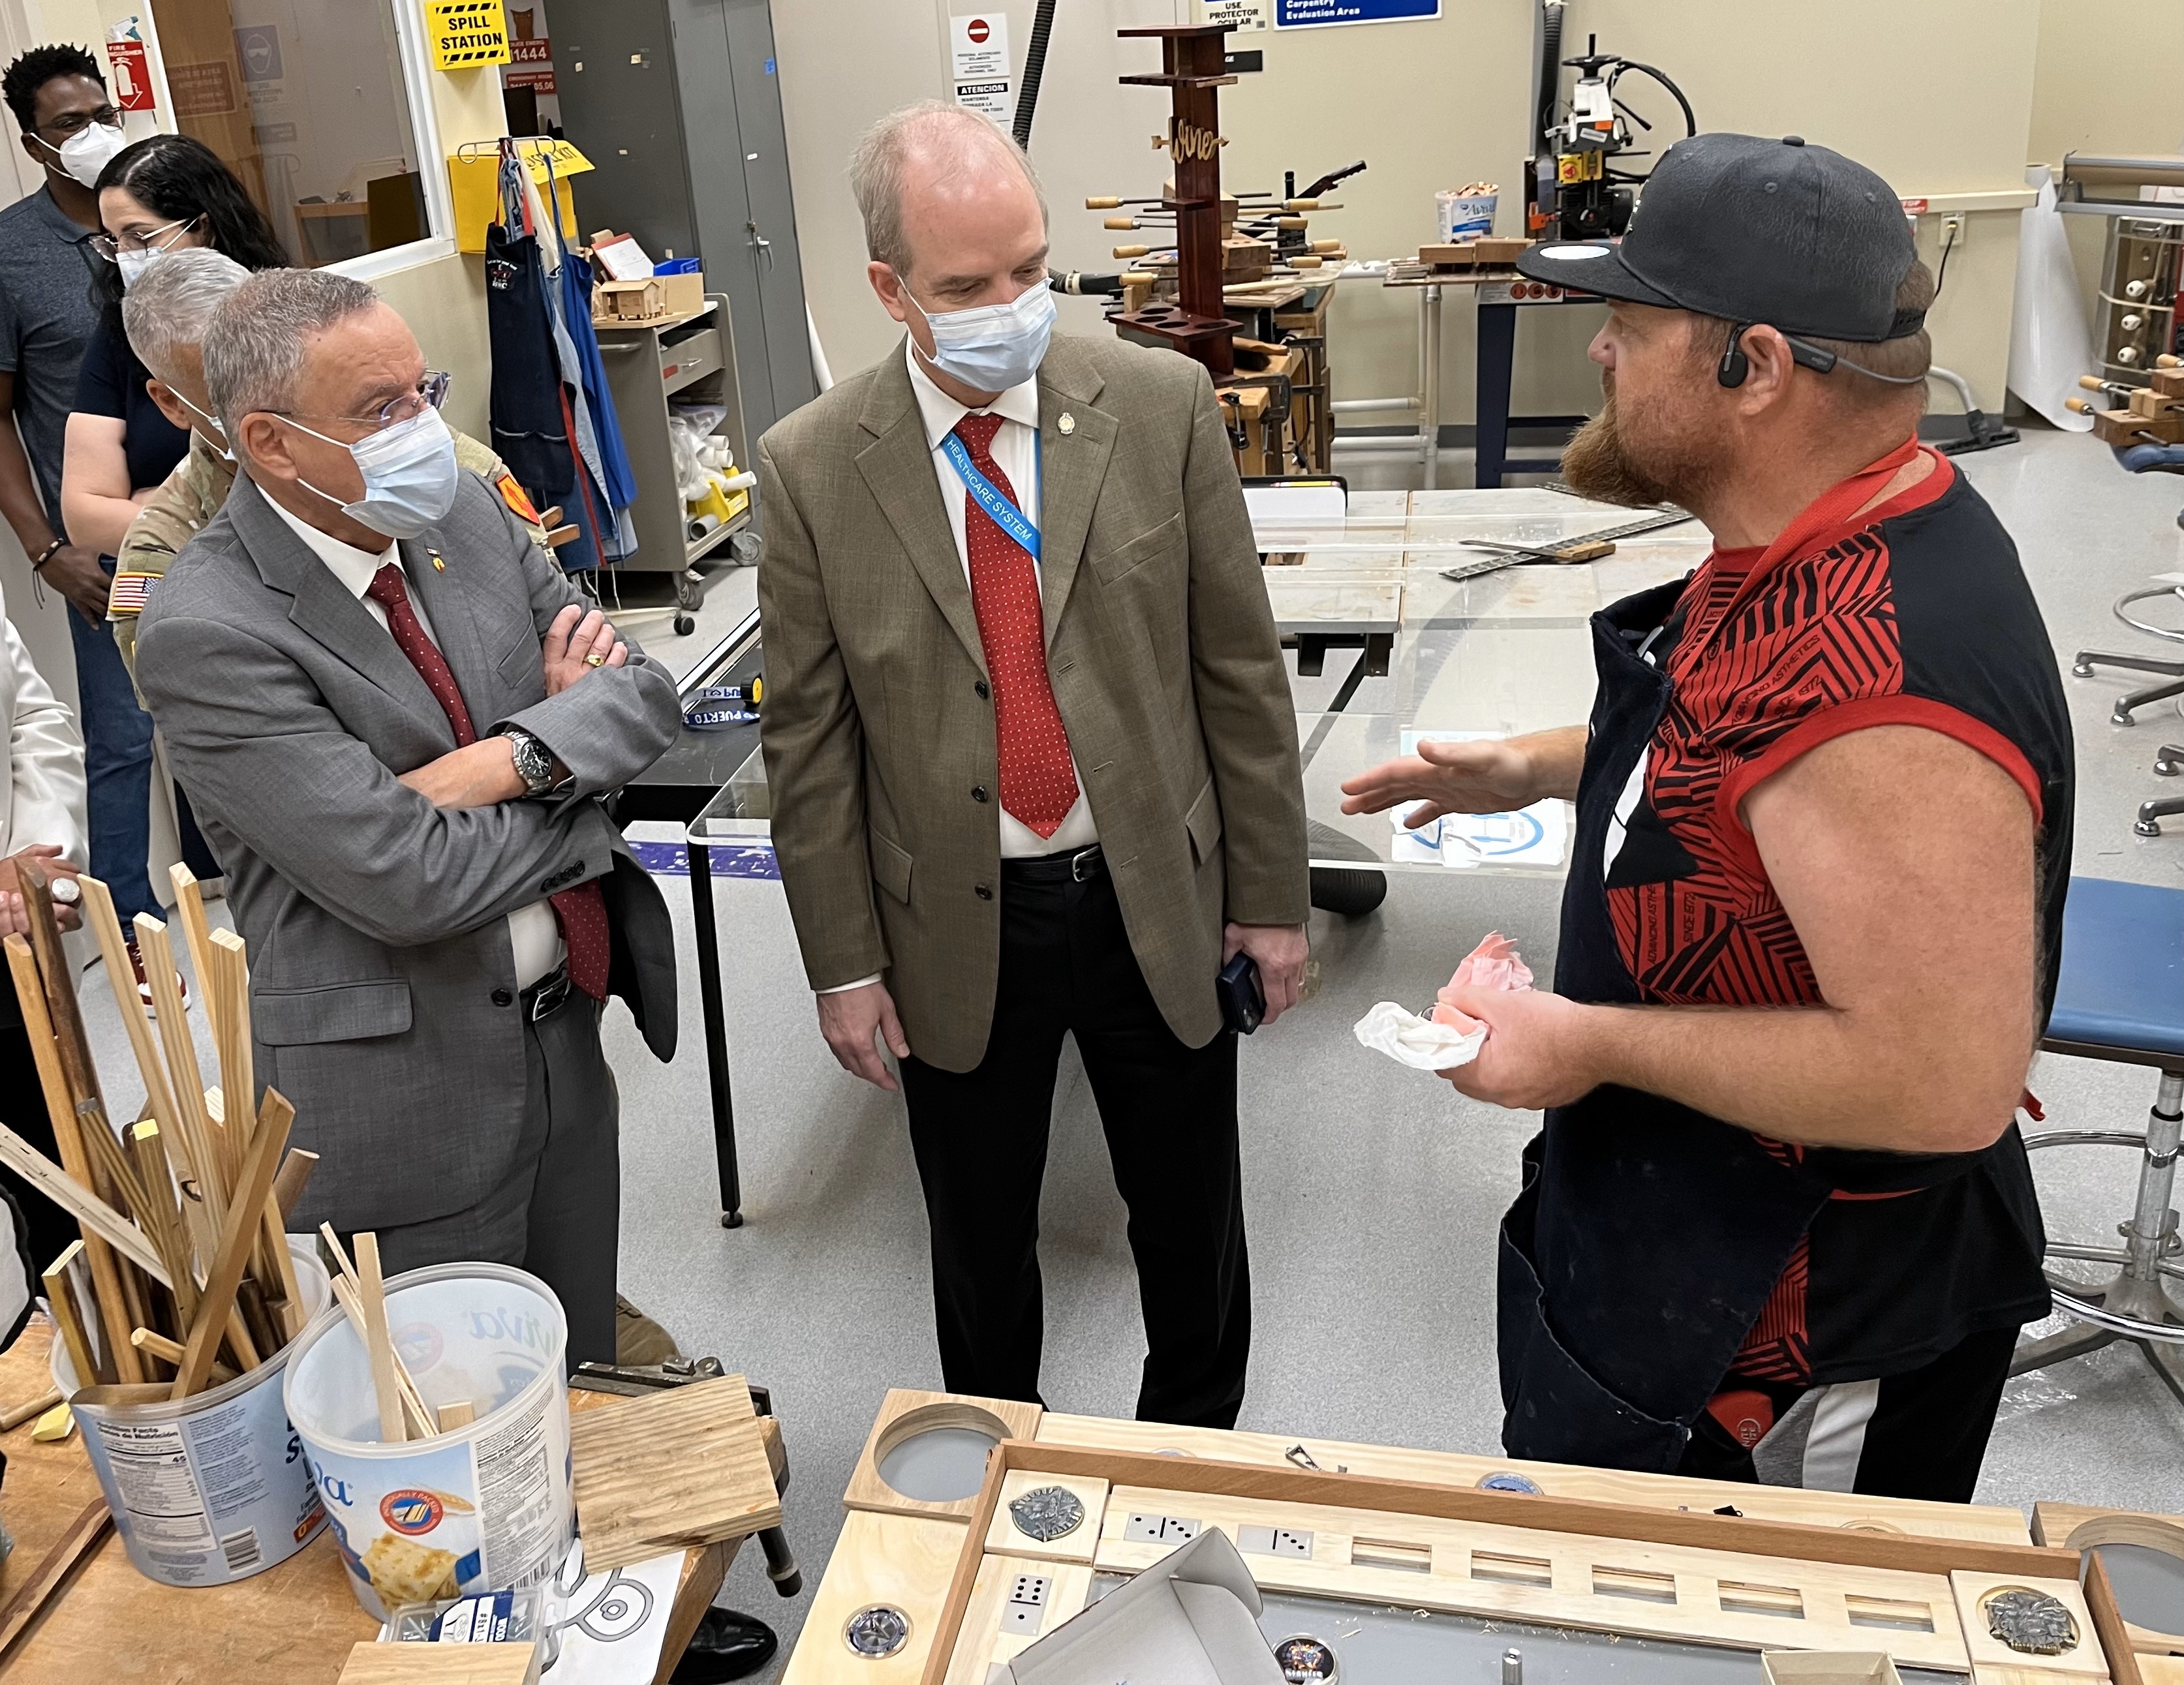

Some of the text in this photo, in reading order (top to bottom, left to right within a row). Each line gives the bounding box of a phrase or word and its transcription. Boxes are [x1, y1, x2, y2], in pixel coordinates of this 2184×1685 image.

[1210, 8, 1259, 19] PROTECTOR
[1286, 7, 1360, 20] Evaluation Area
[448, 16, 490, 31] SPILL
[441, 33, 502, 50] STATION
[961, 84, 1004, 94] ATENCION
[947, 440, 1032, 541] HEALTHCARE SYSTEM
[694, 710, 742, 724] PUERTO
